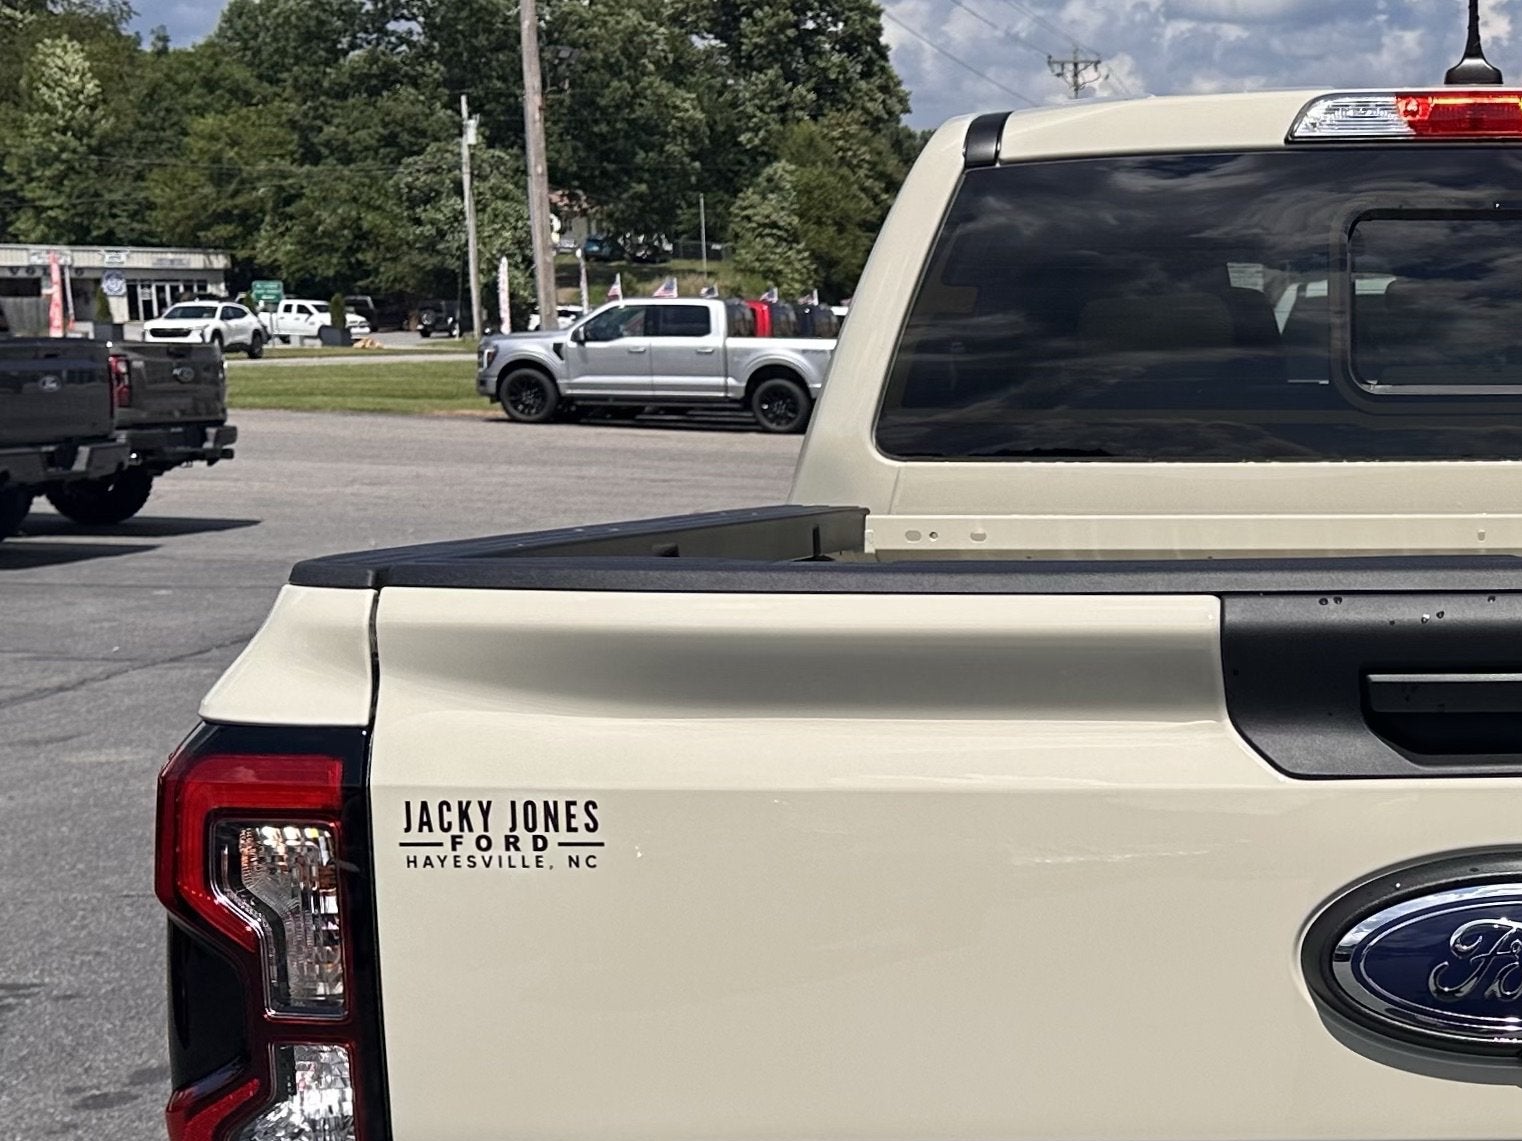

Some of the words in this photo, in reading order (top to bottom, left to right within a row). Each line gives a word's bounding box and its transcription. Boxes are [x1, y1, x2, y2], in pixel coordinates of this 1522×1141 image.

[404, 800, 493, 833] JACKY
[509, 800, 599, 833] JONES
[450, 834, 549, 852] FORD
[406, 855, 554, 871] HAYESVILLE,
[568, 855, 598, 869] NC
